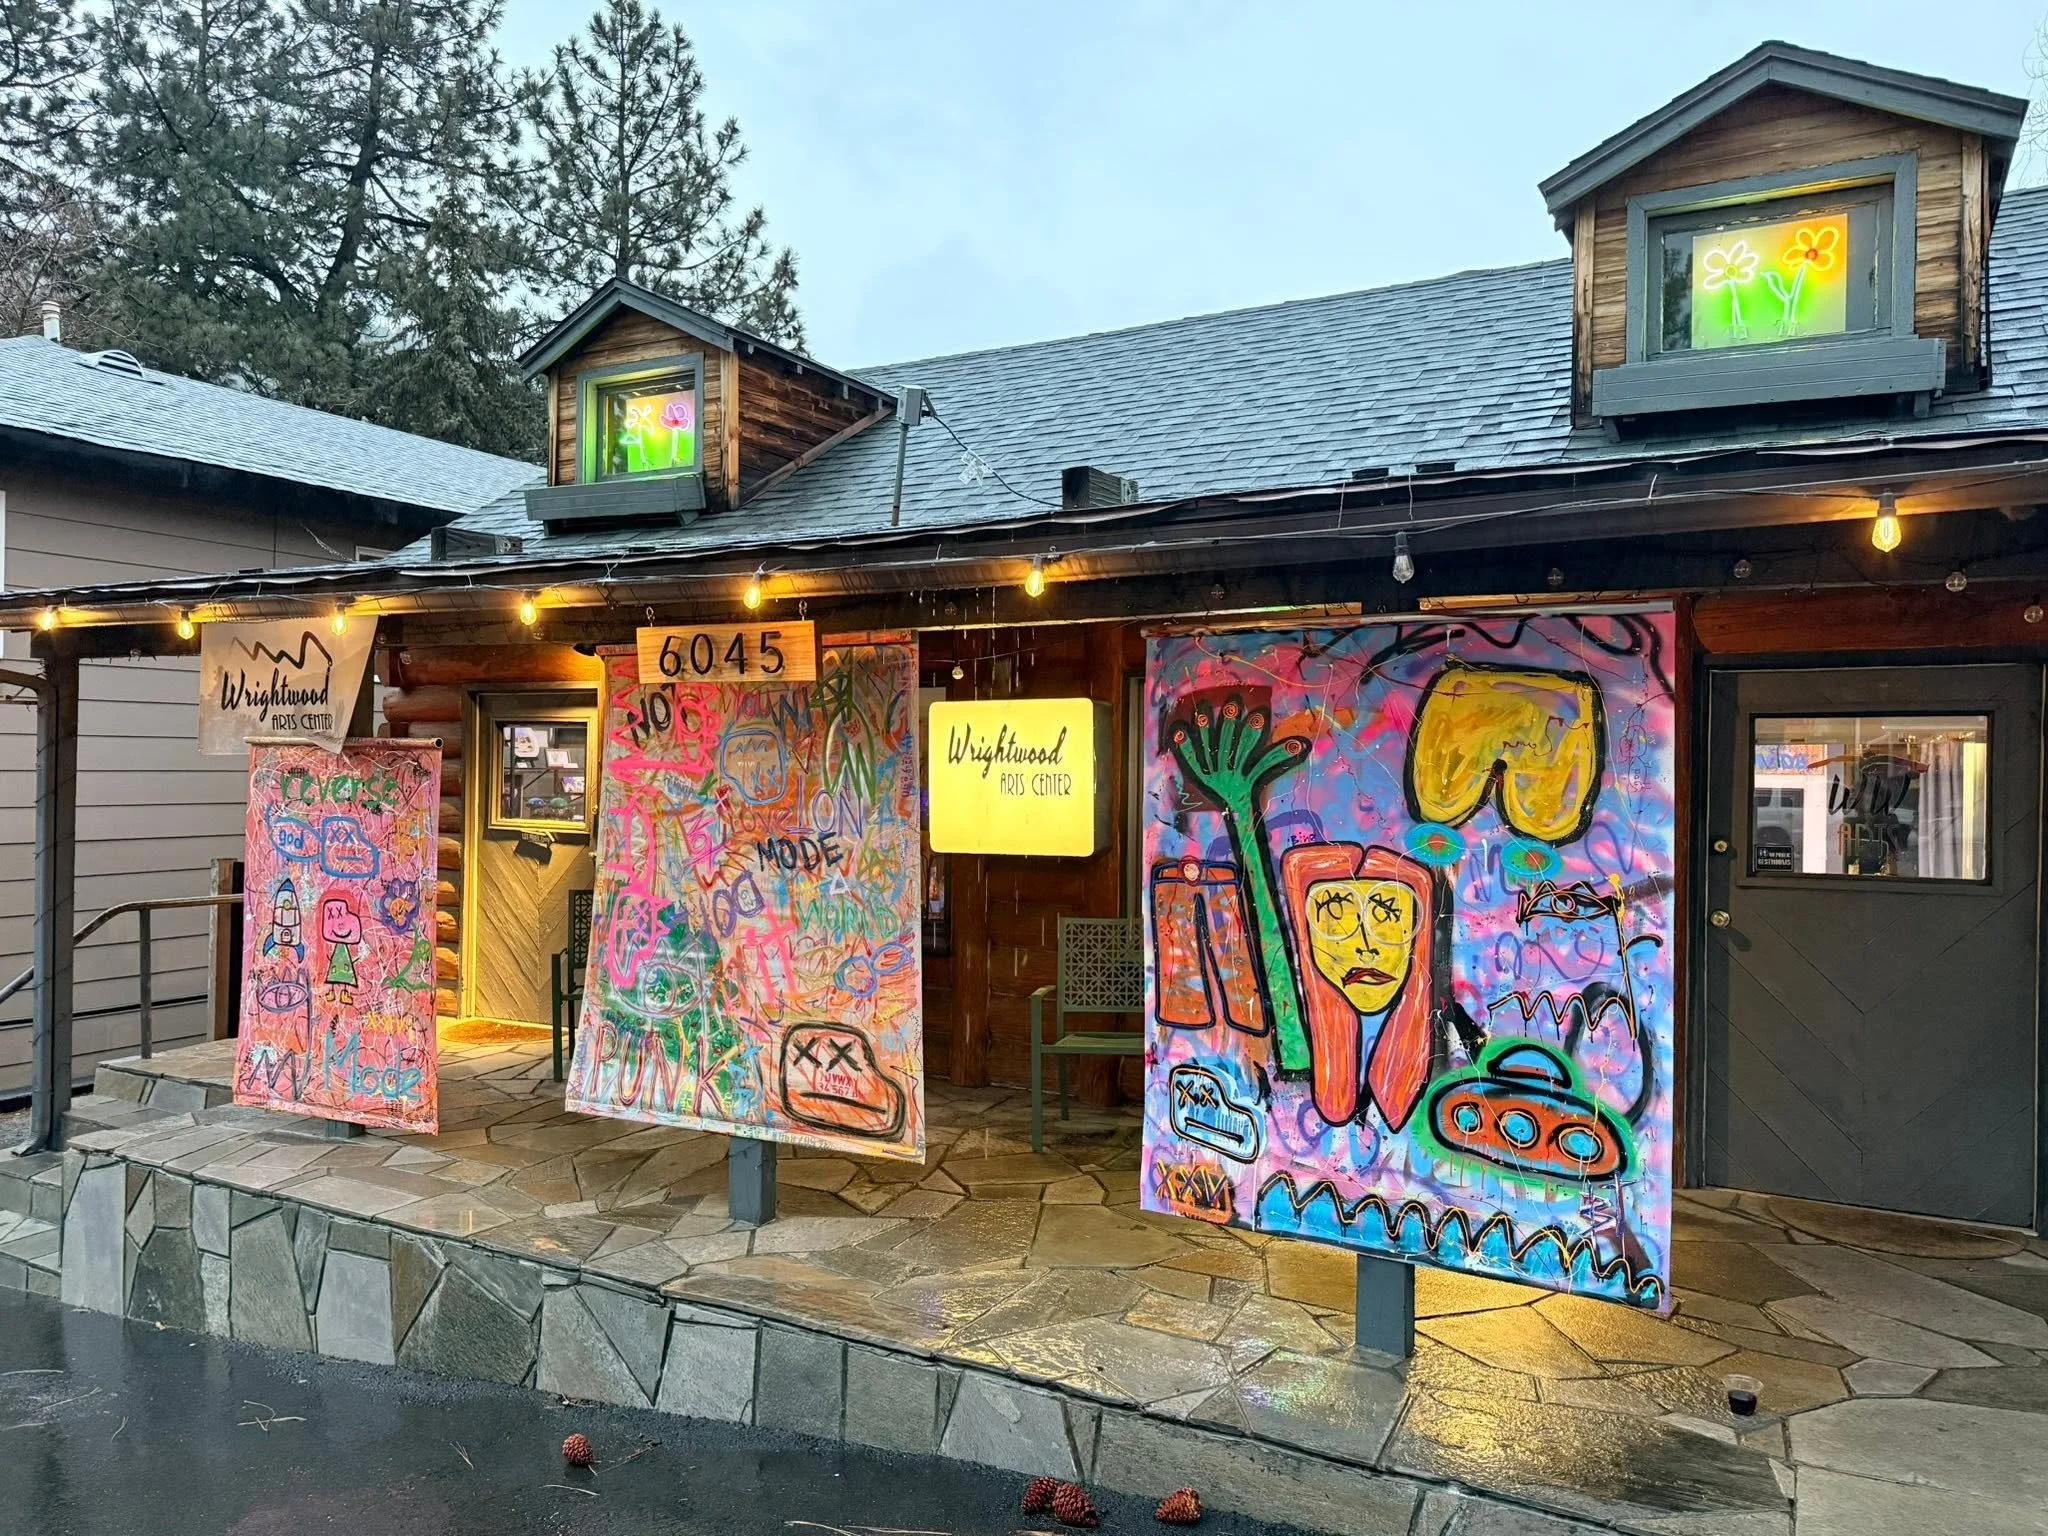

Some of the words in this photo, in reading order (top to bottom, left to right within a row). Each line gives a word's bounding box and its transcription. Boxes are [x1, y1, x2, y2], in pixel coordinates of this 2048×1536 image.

[659, 631, 785, 676] 6045
[221, 666, 331, 722] Wrightwood
[271, 714, 298, 731] ARTS
[300, 714, 333, 731] CENTER
[948, 722, 1067, 779] Wrightwood
[1000, 773, 1025, 796] ARTS
[1031, 773, 1072, 796] CENTER
[278, 829, 305, 849] god
[757, 832, 843, 873] MODE
[797, 898, 898, 939] WORLD
[324, 1030, 423, 1100] Mode
[590, 1020, 729, 1118] PUNK
